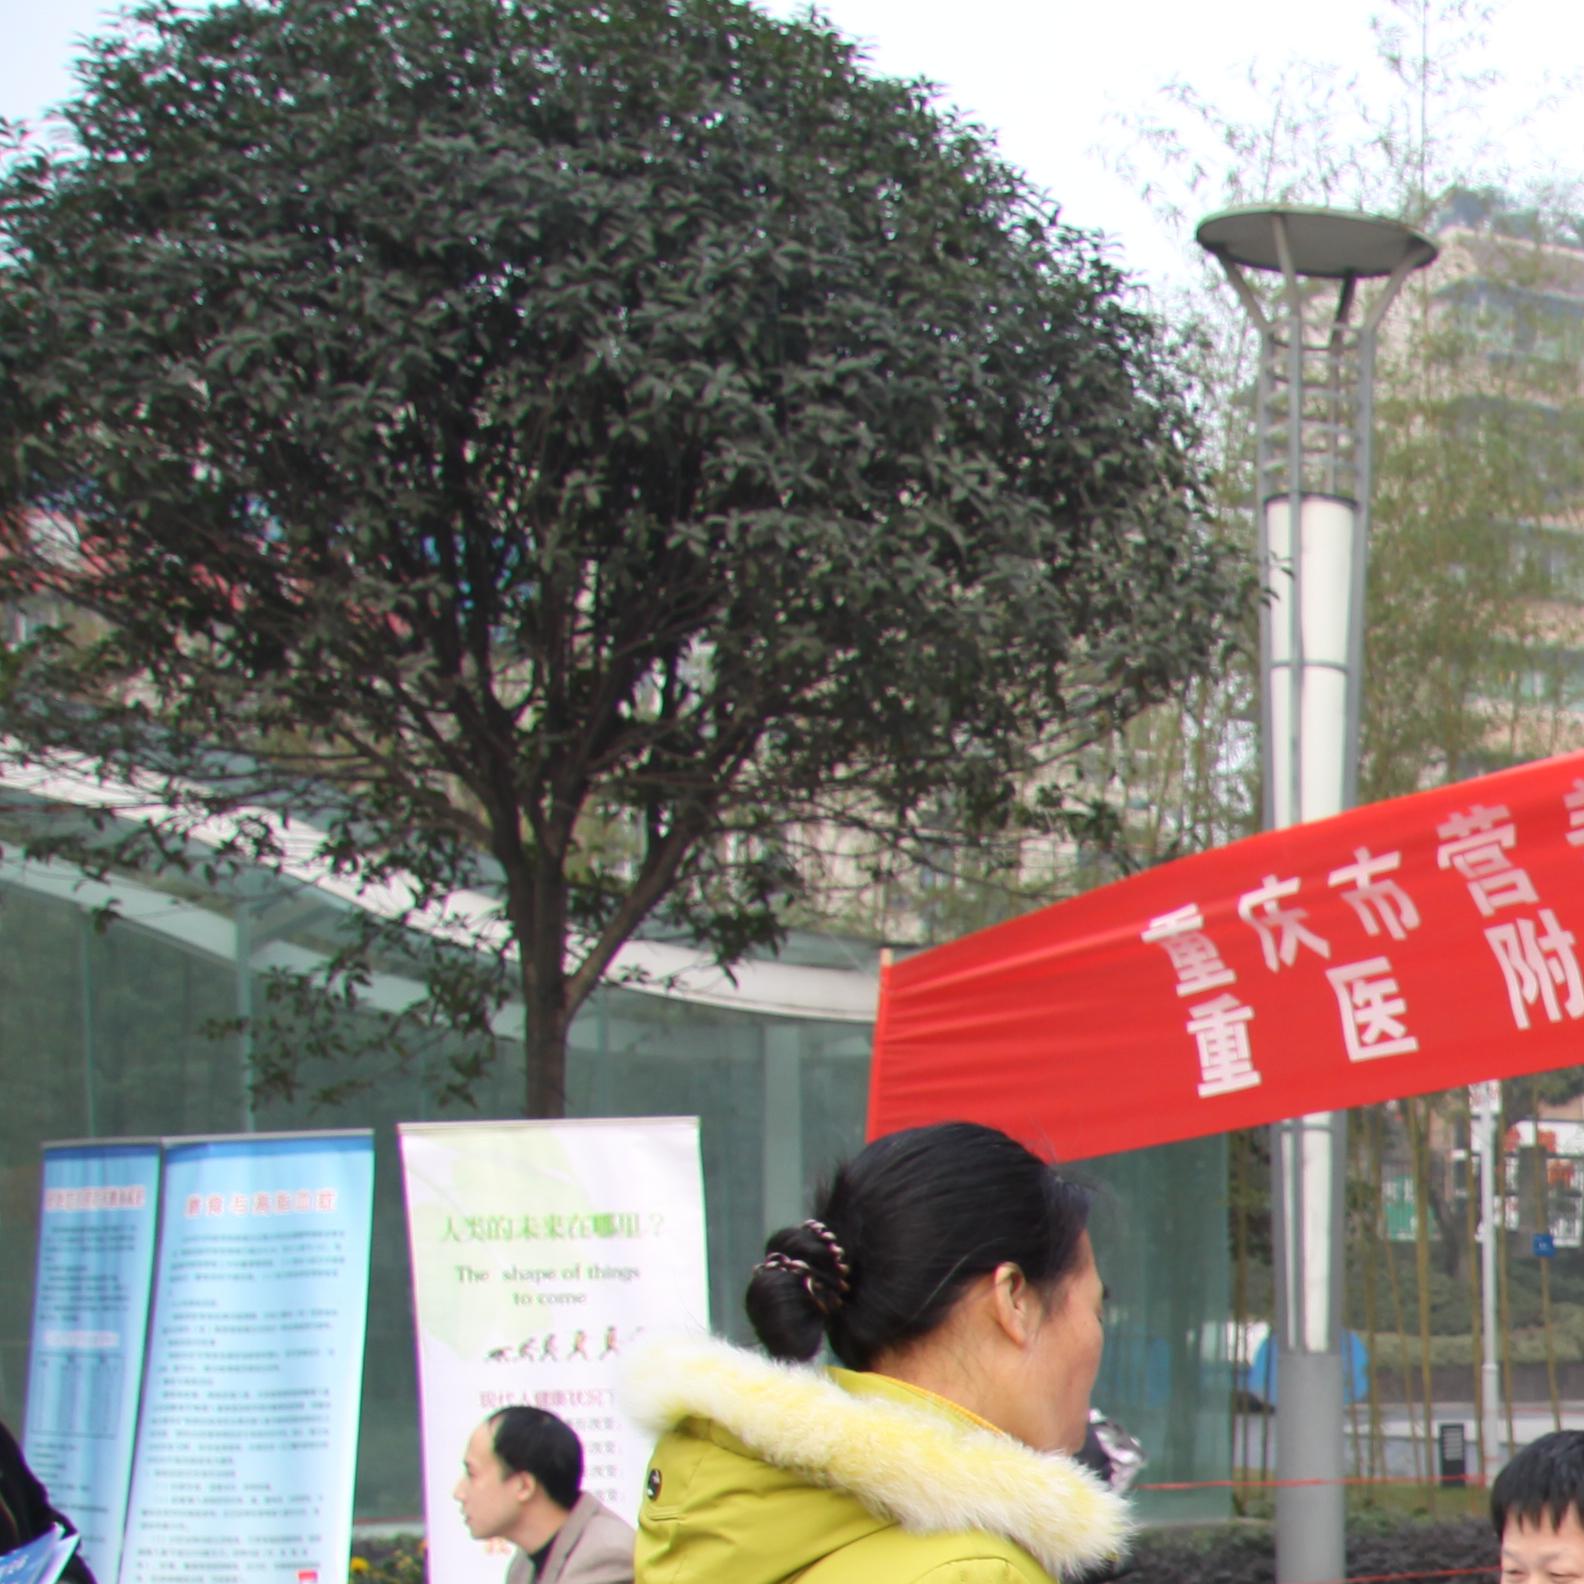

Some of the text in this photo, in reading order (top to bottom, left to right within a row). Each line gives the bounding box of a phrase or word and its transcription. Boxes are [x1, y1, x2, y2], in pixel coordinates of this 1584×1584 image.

[455, 1263, 640, 1284] The shape of things
[513, 1292, 586, 1306] to come
